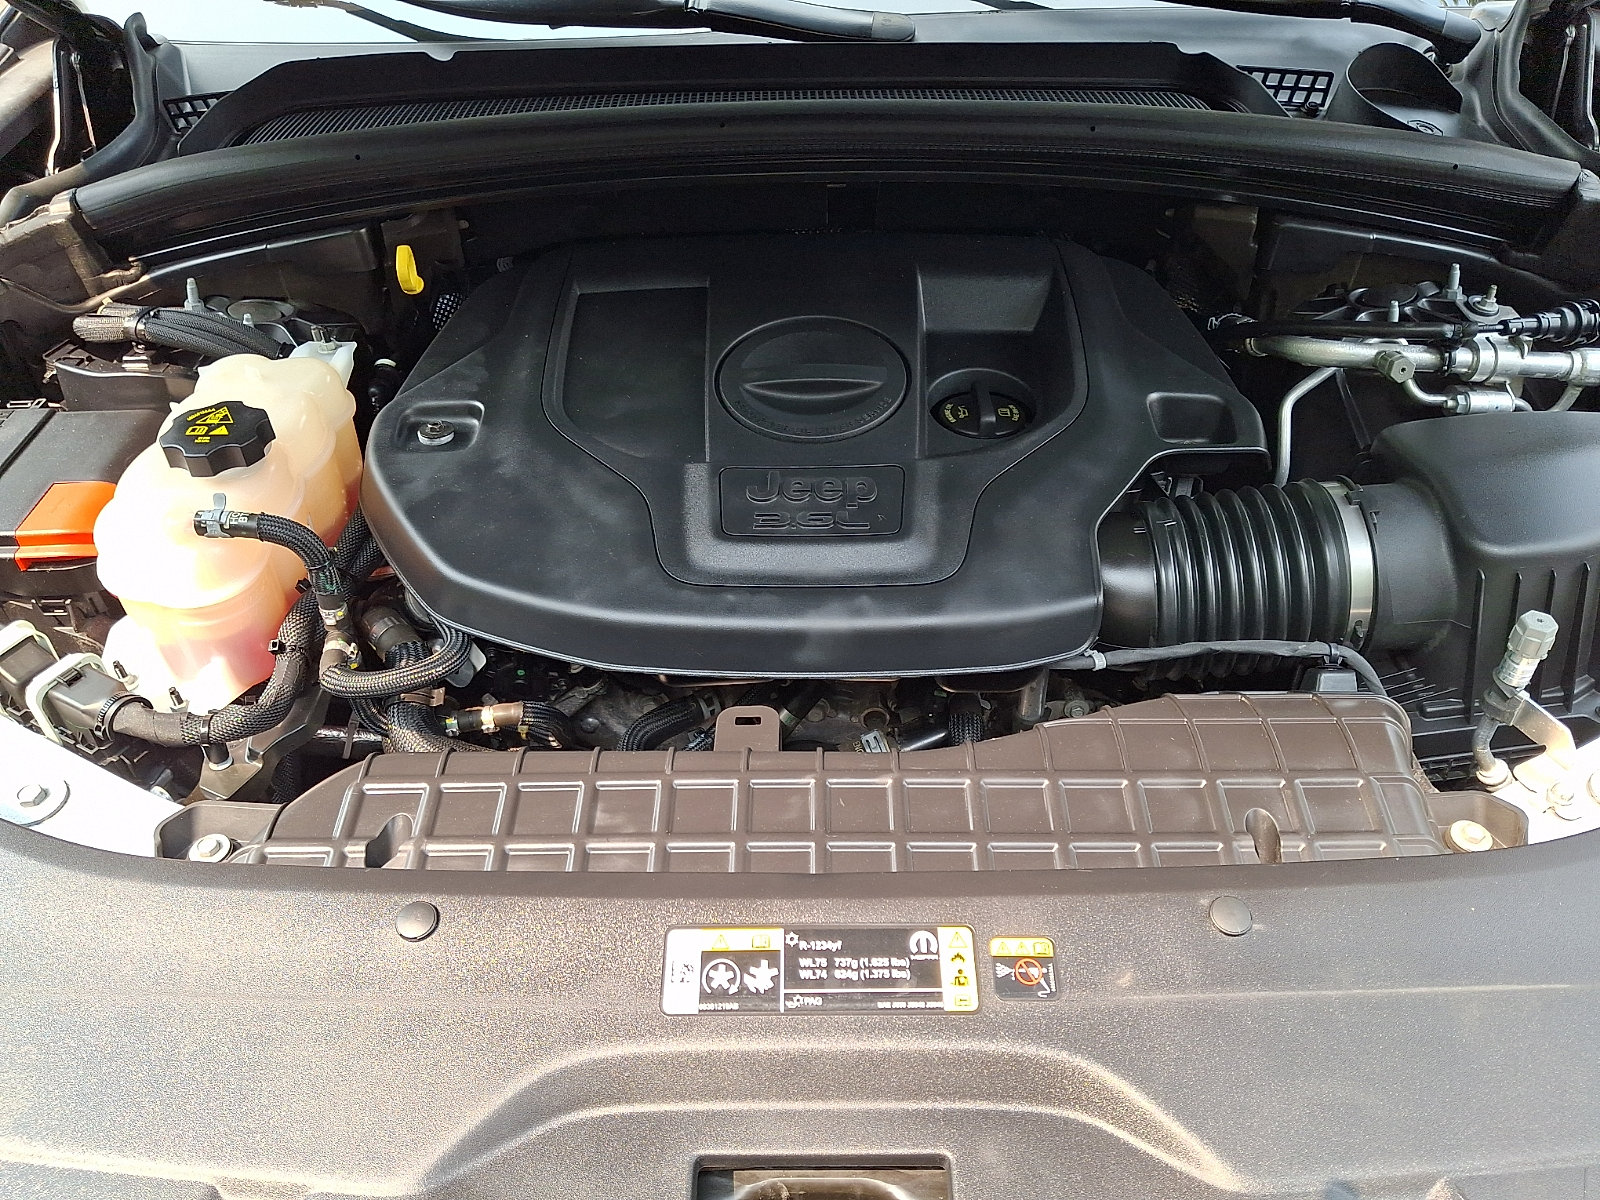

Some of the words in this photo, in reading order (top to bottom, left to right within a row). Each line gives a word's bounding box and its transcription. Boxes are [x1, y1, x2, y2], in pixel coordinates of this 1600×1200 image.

[746, 470, 878, 508] Jeep
[752, 511, 871, 530] 3.6L
[799, 957, 828, 968] WL75
[799, 969, 828, 980] WL74
